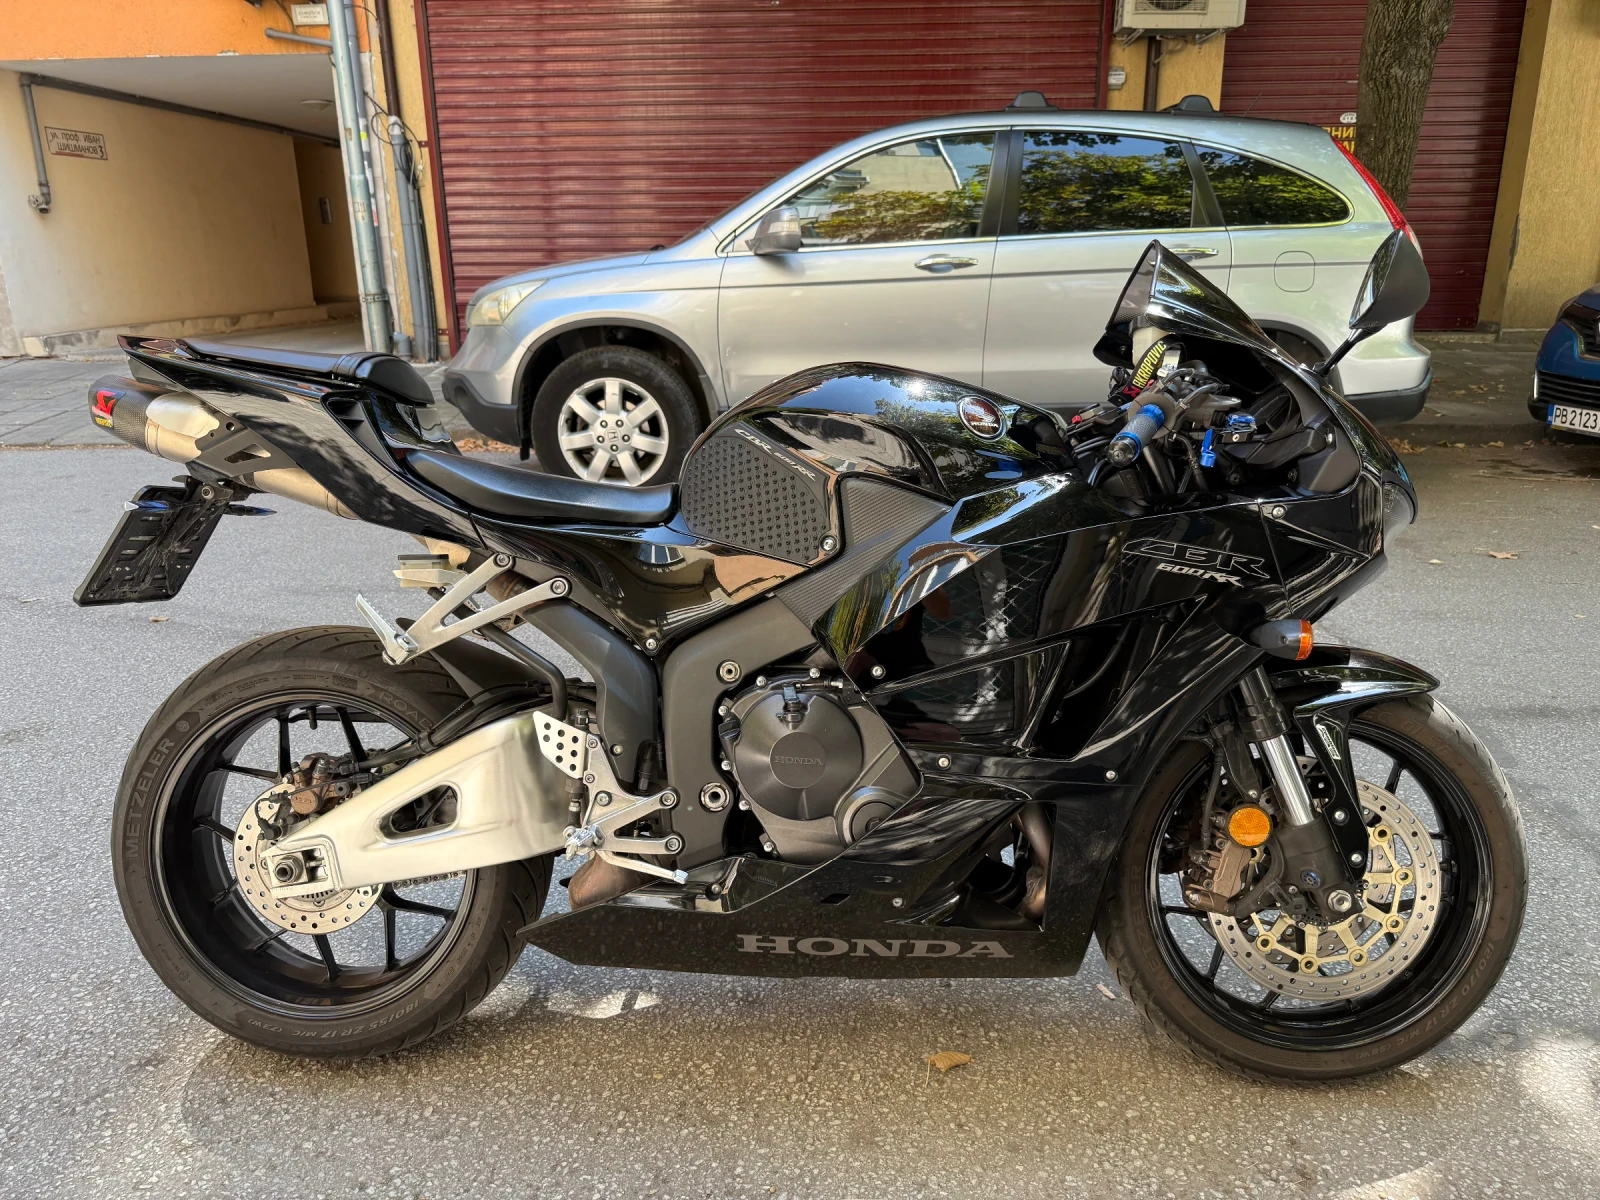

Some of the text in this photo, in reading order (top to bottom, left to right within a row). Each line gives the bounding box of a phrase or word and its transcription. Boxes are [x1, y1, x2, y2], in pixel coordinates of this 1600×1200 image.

[57, 142, 98, 154] ШИШМАНОВ
[61, 132, 82, 144] проф.
[83, 134, 101, 144] ИВАН
[98, 145, 104, 158] 3
[1553, 407, 1598, 430] PB 2123
[734, 428, 772, 455] CBR
[1121, 537, 1271, 579] CBR
[1155, 562, 1244, 588] 600RR
[773, 755, 824, 766] HONDA
[125, 737, 175, 858] METZELER
[1130, 864, 1174, 992] METZELER
[736, 933, 1015, 958] HONDA
[368, 998, 419, 1031] 180/55
